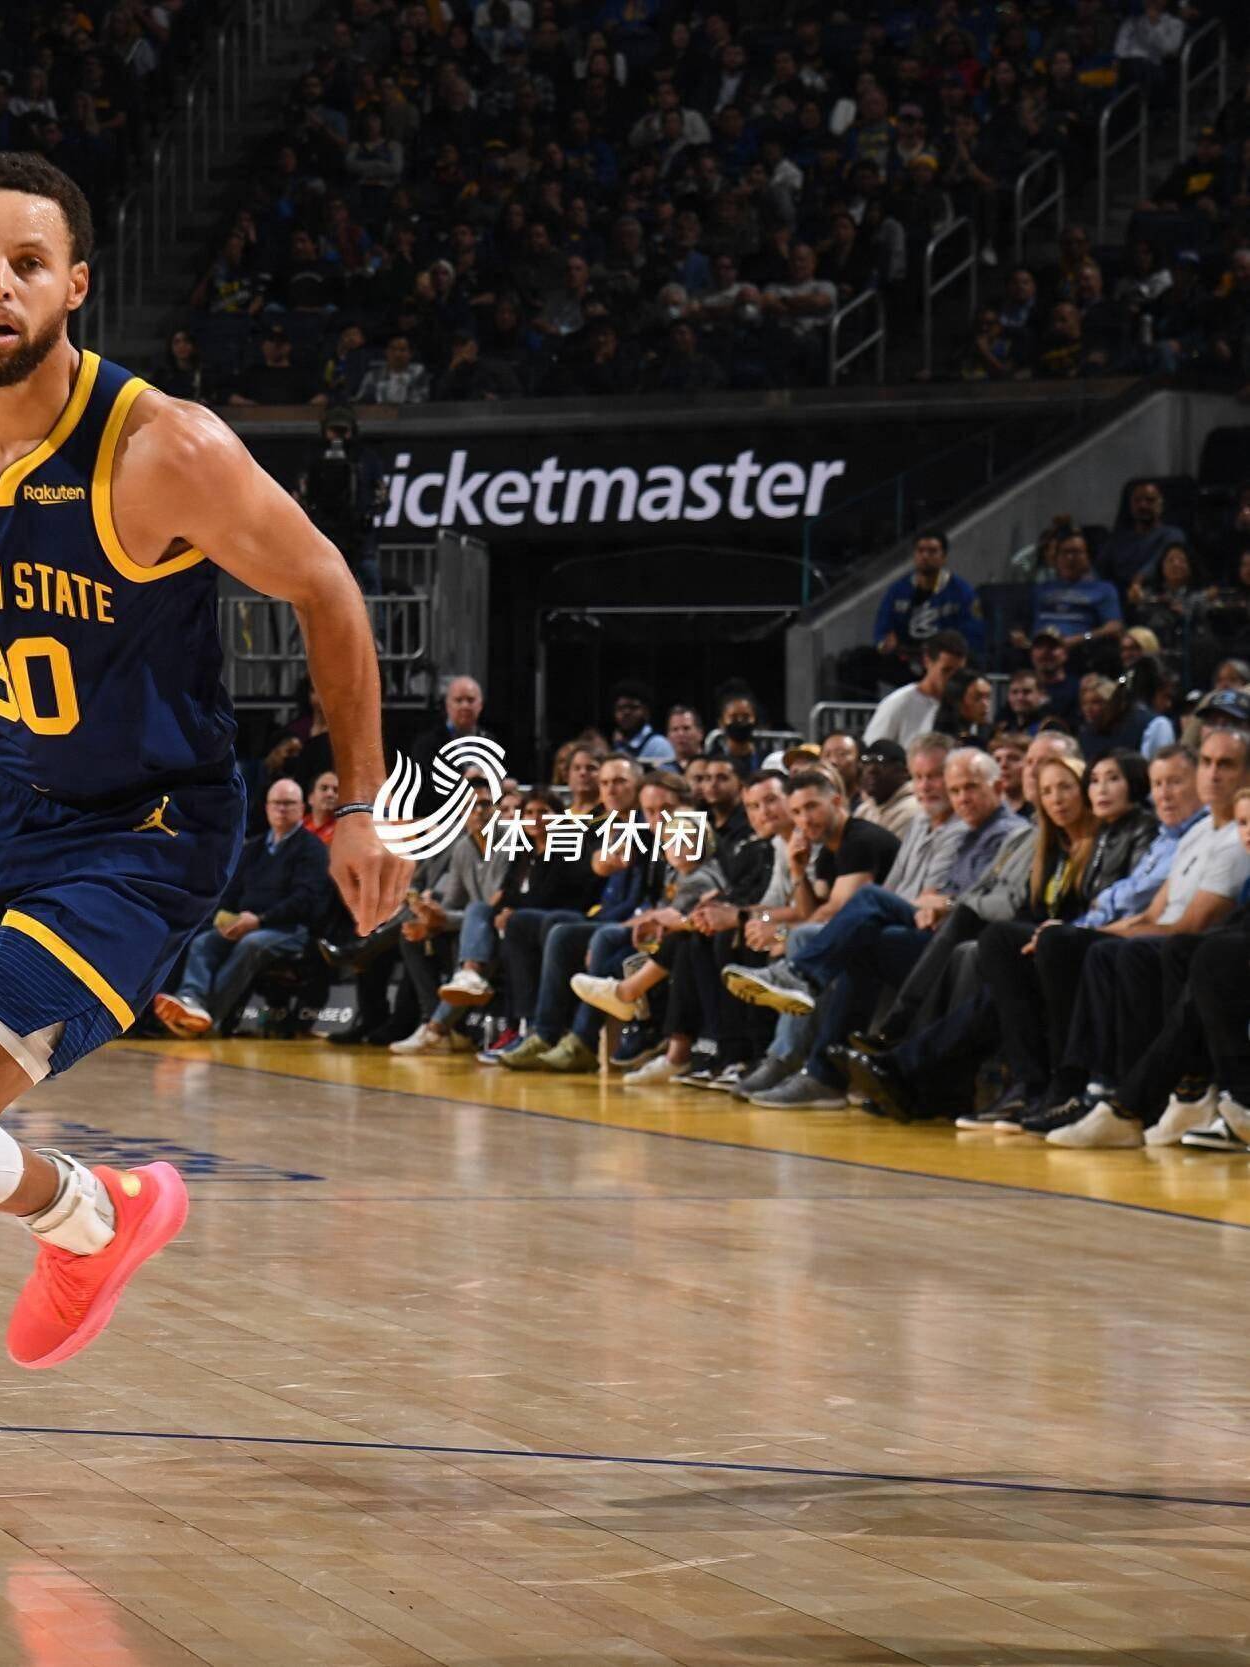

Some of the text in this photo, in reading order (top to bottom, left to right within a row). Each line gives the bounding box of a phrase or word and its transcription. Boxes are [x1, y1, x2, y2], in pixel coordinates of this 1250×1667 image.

[23, 483, 86, 501] Rakuten
[373, 450, 845, 528] icketmaster
[13, 562, 115, 624] STATE
